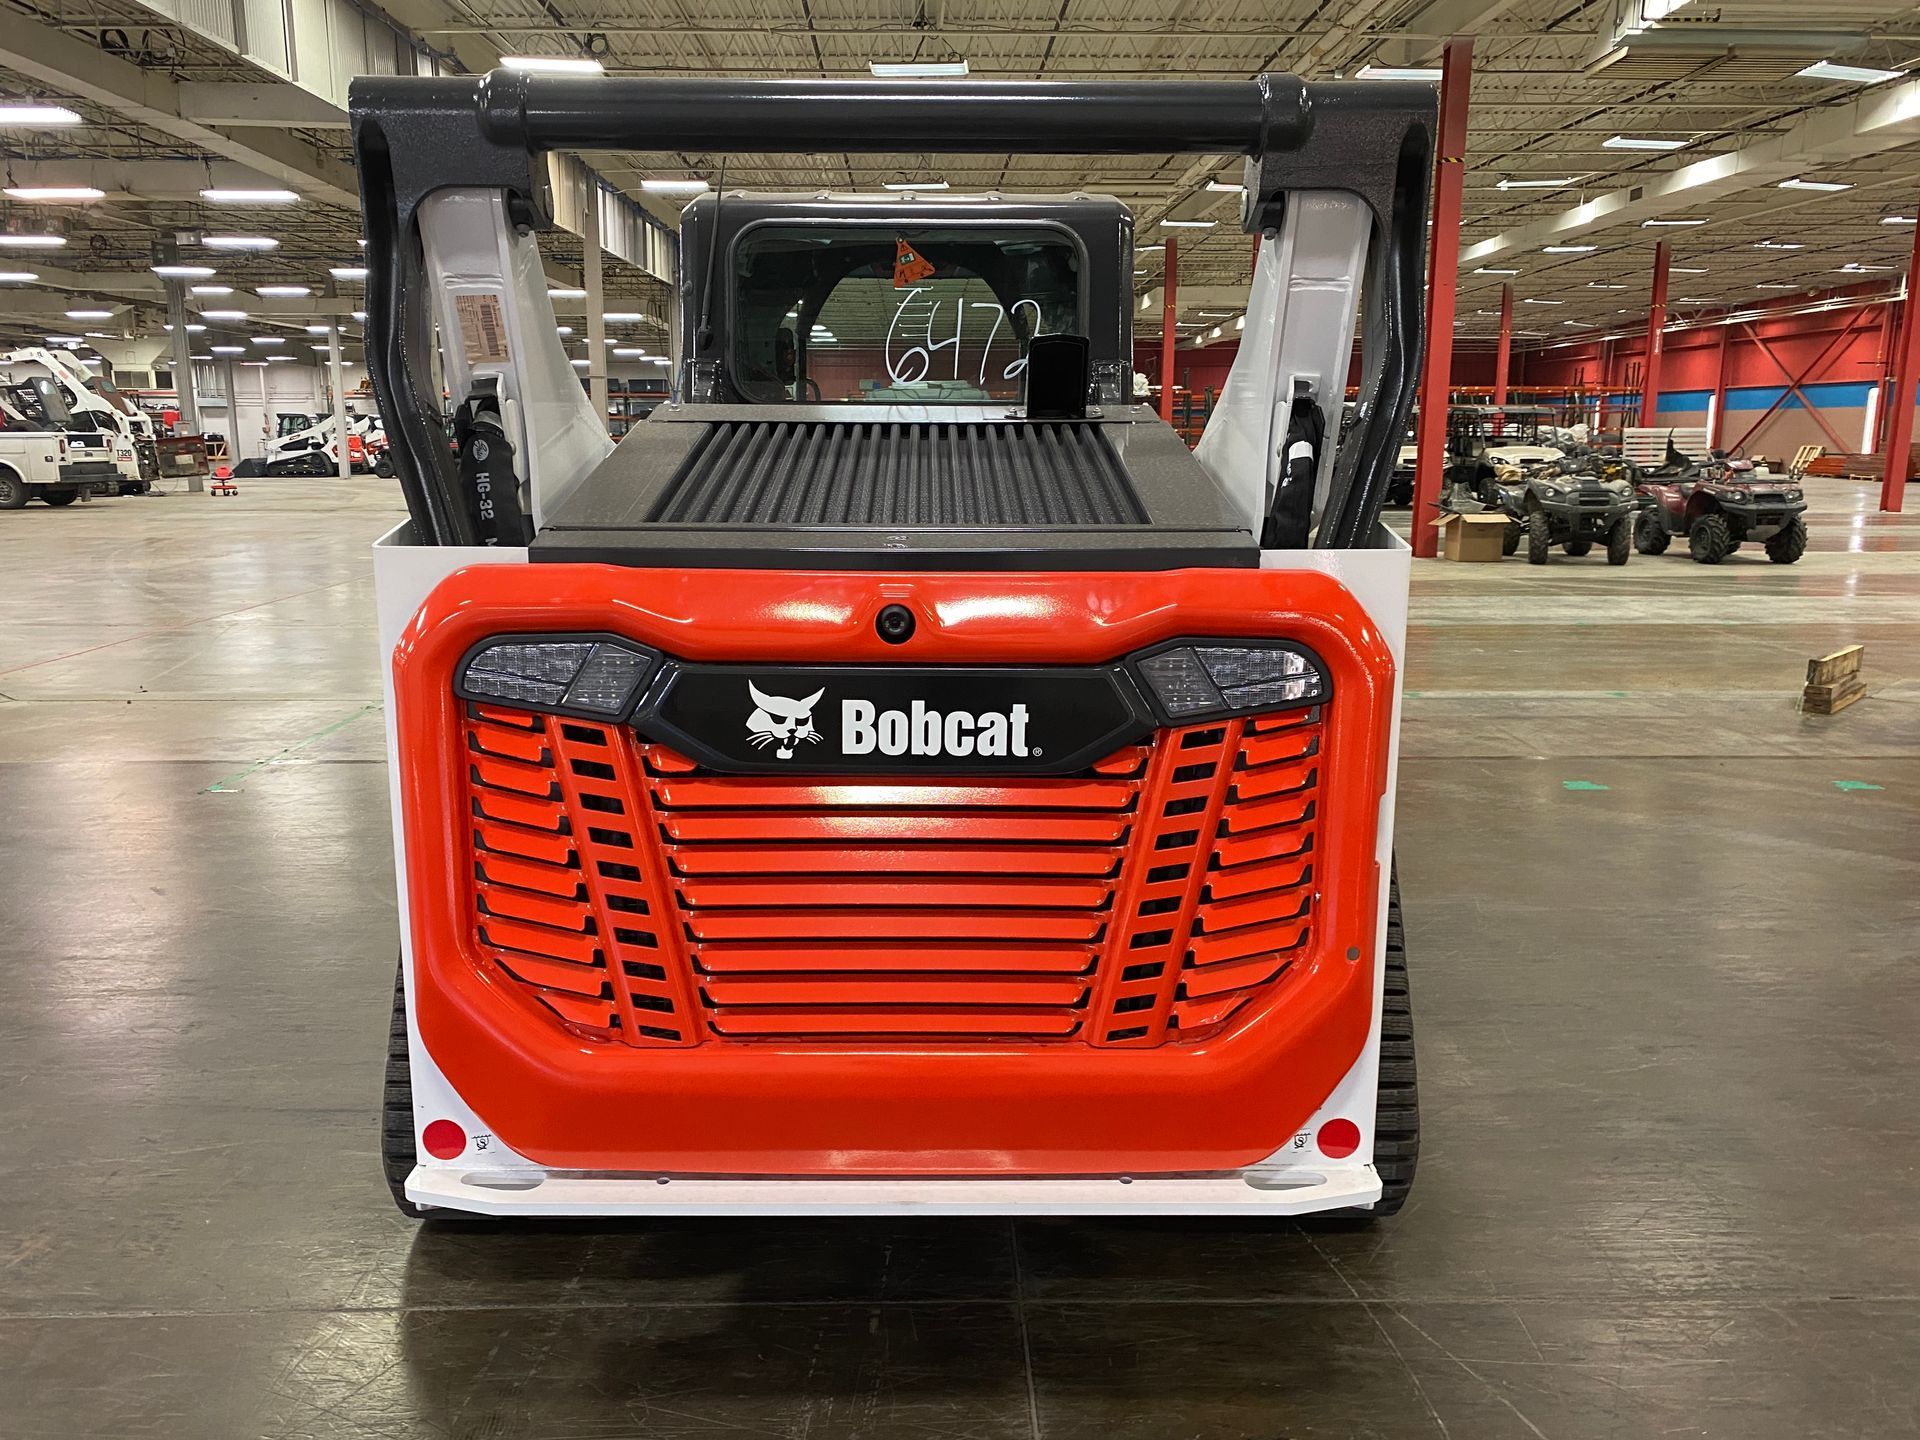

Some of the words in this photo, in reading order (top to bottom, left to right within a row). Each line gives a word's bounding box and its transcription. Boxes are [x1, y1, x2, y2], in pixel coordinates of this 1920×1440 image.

[885, 287, 1041, 385] 6472
[116, 449, 132, 457] T320
[475, 472, 495, 521] HG-32
[842, 699, 1029, 757] Bobcat
